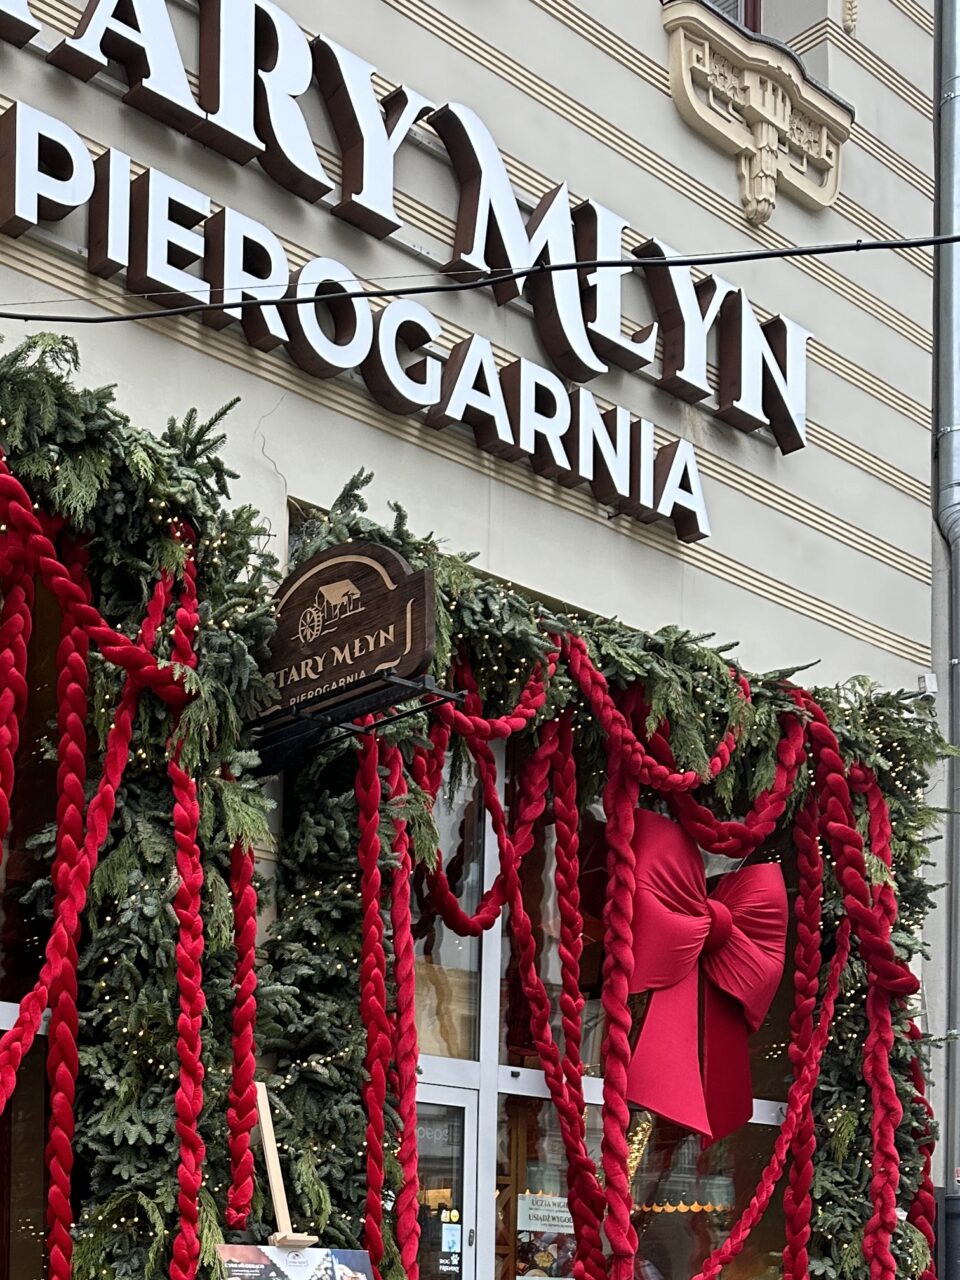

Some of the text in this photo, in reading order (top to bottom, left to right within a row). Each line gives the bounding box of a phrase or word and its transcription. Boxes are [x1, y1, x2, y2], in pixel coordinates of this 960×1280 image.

[427, 103, 815, 455] MŁYN
[276, 624, 395, 689] TARY MŁYN
[289, 669, 366, 706] PIEROGARNIA
